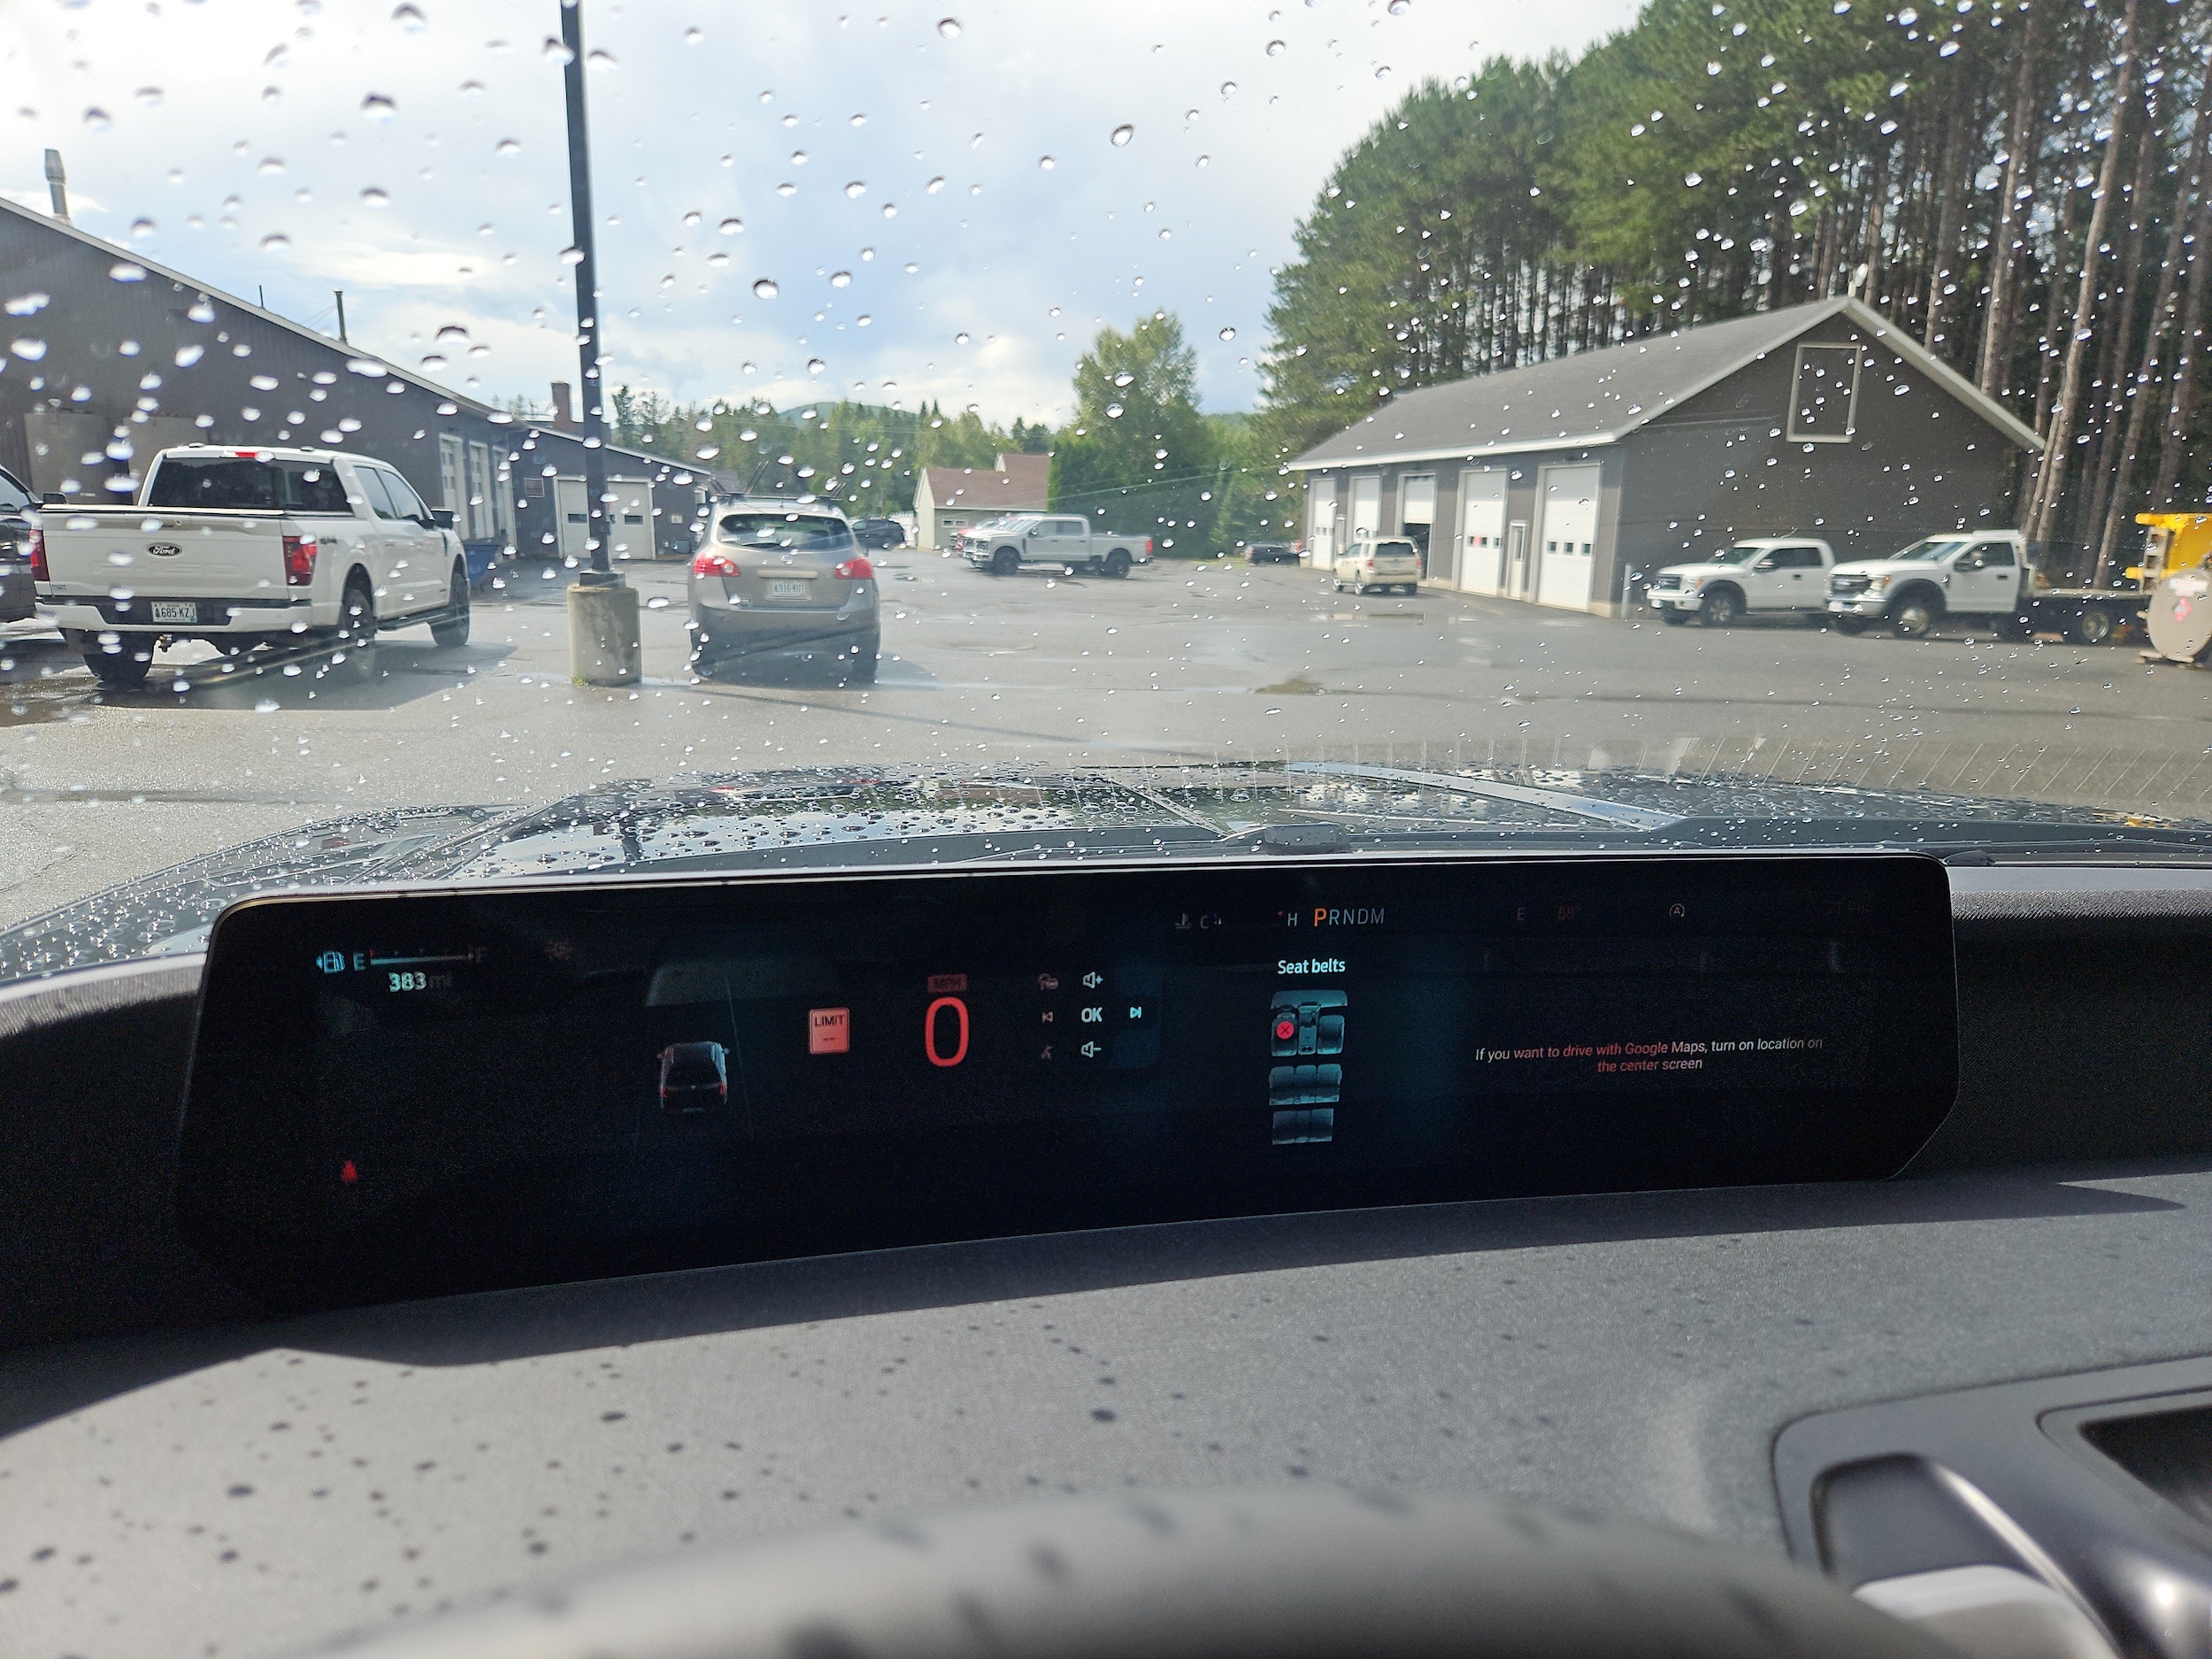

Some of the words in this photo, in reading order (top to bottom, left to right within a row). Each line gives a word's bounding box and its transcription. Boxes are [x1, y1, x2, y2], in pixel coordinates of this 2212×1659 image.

[153, 546, 176, 555] Ford
[1286, 912, 1298, 927] H
[353, 952, 365, 972] E
[1278, 960, 1309, 975] Seat
[1311, 957, 1346, 973] belts
[388, 972, 427, 992] 383
[814, 1015, 845, 1026] LIMIT
[1080, 1007, 1103, 1023] OK
[925, 996, 970, 1067] 0
[1475, 1048, 1486, 1061] If
[1487, 1049, 1510, 1064] you
[1513, 1048, 1544, 1059] want
[1548, 1047, 1560, 1057] to
[1563, 1044, 1593, 1057] drive
[1595, 1042, 1622, 1056] with
[1624, 1041, 1669, 1056] Google
[1671, 1041, 1709, 1055] Maps,
[1710, 1041, 1736, 1052] turn
[1738, 1040, 1755, 1051] on
[1757, 1037, 1805, 1050] location
[1807, 1038, 1824, 1048] on
[1597, 1061, 1617, 1073] the
[1619, 1060, 1658, 1071] center
[1662, 1058, 1703, 1071] screen
